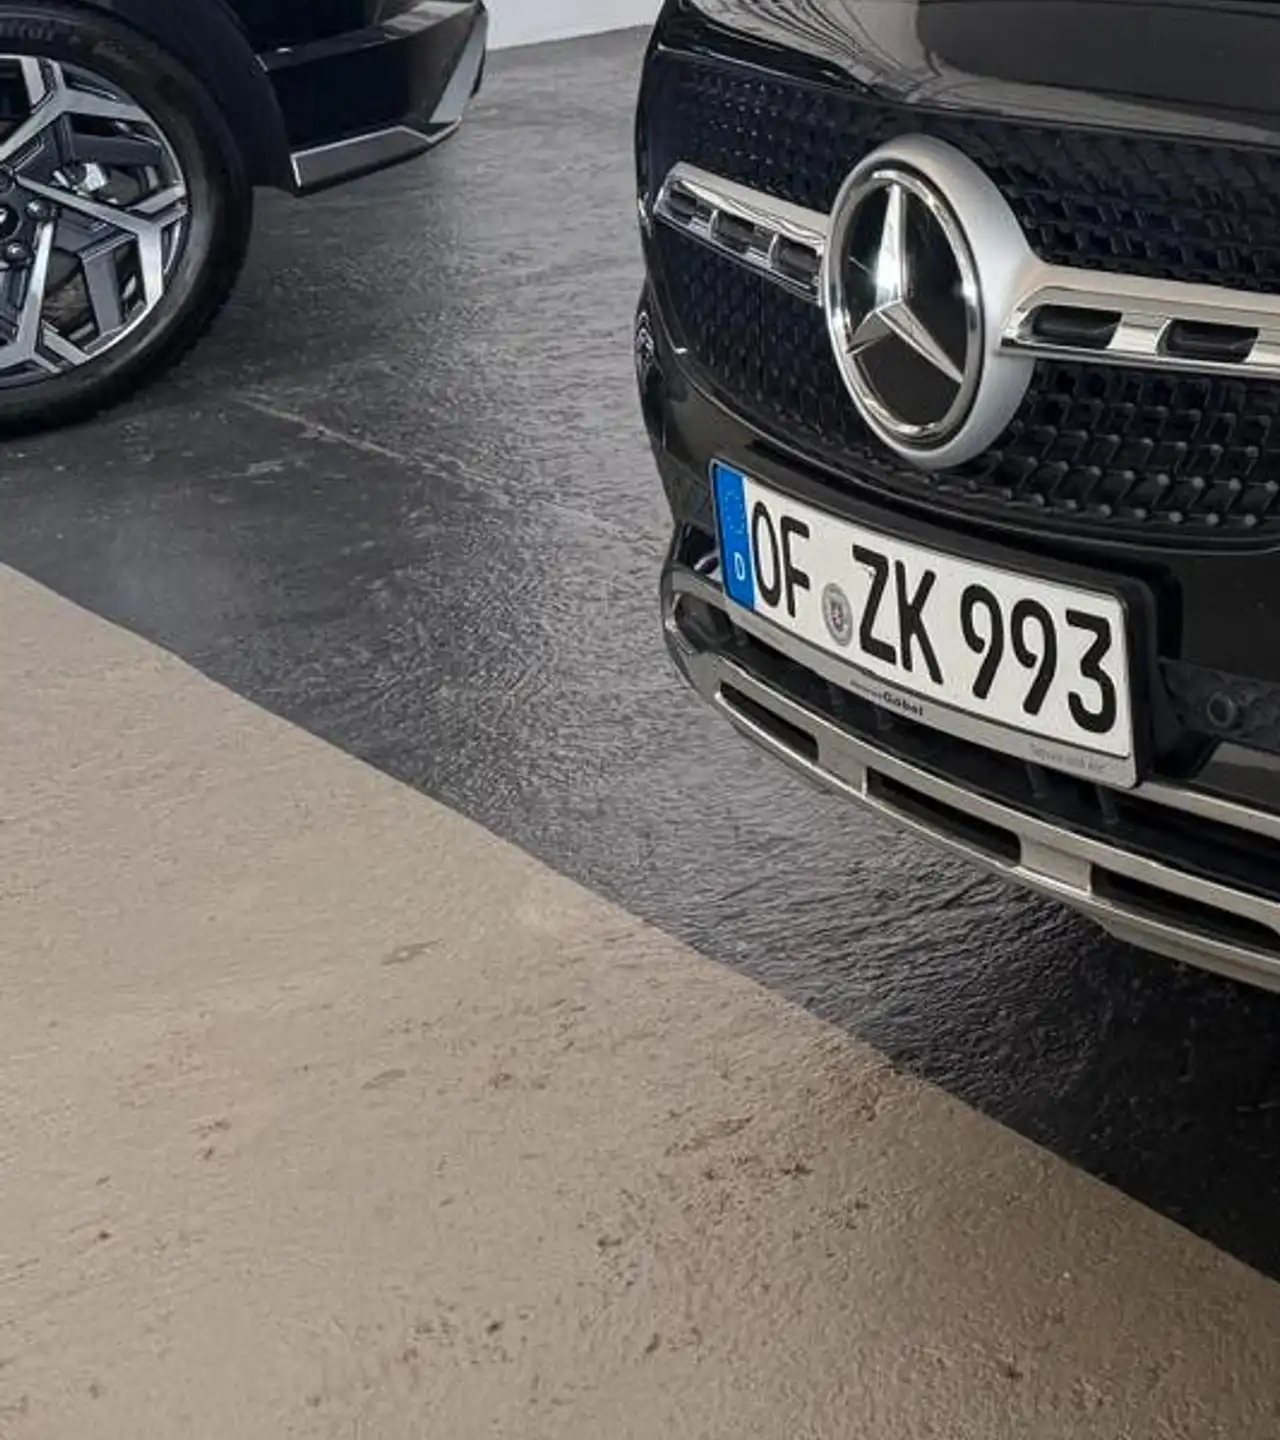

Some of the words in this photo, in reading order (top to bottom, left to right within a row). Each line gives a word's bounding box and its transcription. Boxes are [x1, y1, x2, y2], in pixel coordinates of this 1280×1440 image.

[733, 551, 746, 581] D
[751, 500, 810, 618] OF
[852, 544, 943, 685] ZK
[960, 583, 1117, 733] 993
